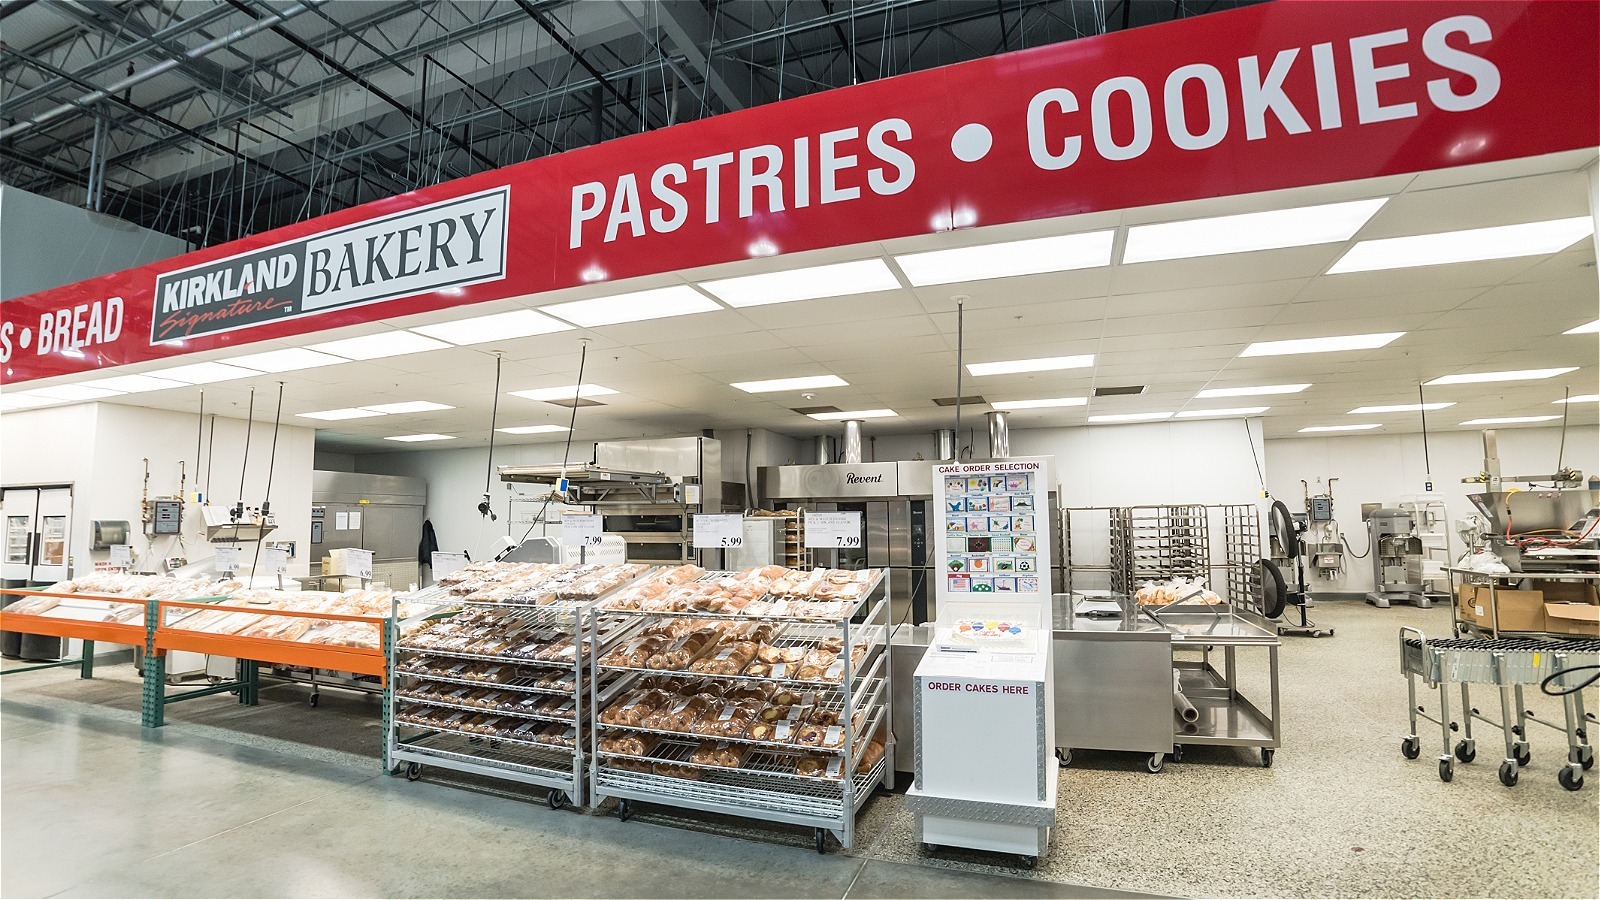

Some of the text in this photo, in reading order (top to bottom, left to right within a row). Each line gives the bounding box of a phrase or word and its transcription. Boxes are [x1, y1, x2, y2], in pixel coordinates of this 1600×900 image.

[569, 15, 1501, 249] PASTRIES COOKIES
[307, 208, 497, 297] BAKERY
[162, 253, 298, 313] KIRKLAND
[159, 297, 293, 338] Signature
[37, 297, 124, 356] BREAD
[938, 462, 1040, 474] CAKE ORDER SELECTION
[846, 472, 882, 485] Revent
[584, 536, 602, 546] 7.99
[720, 536, 742, 547] 5.99
[836, 536, 860, 547] 7.99
[928, 681, 1029, 695] ORDER CAKES HERE
